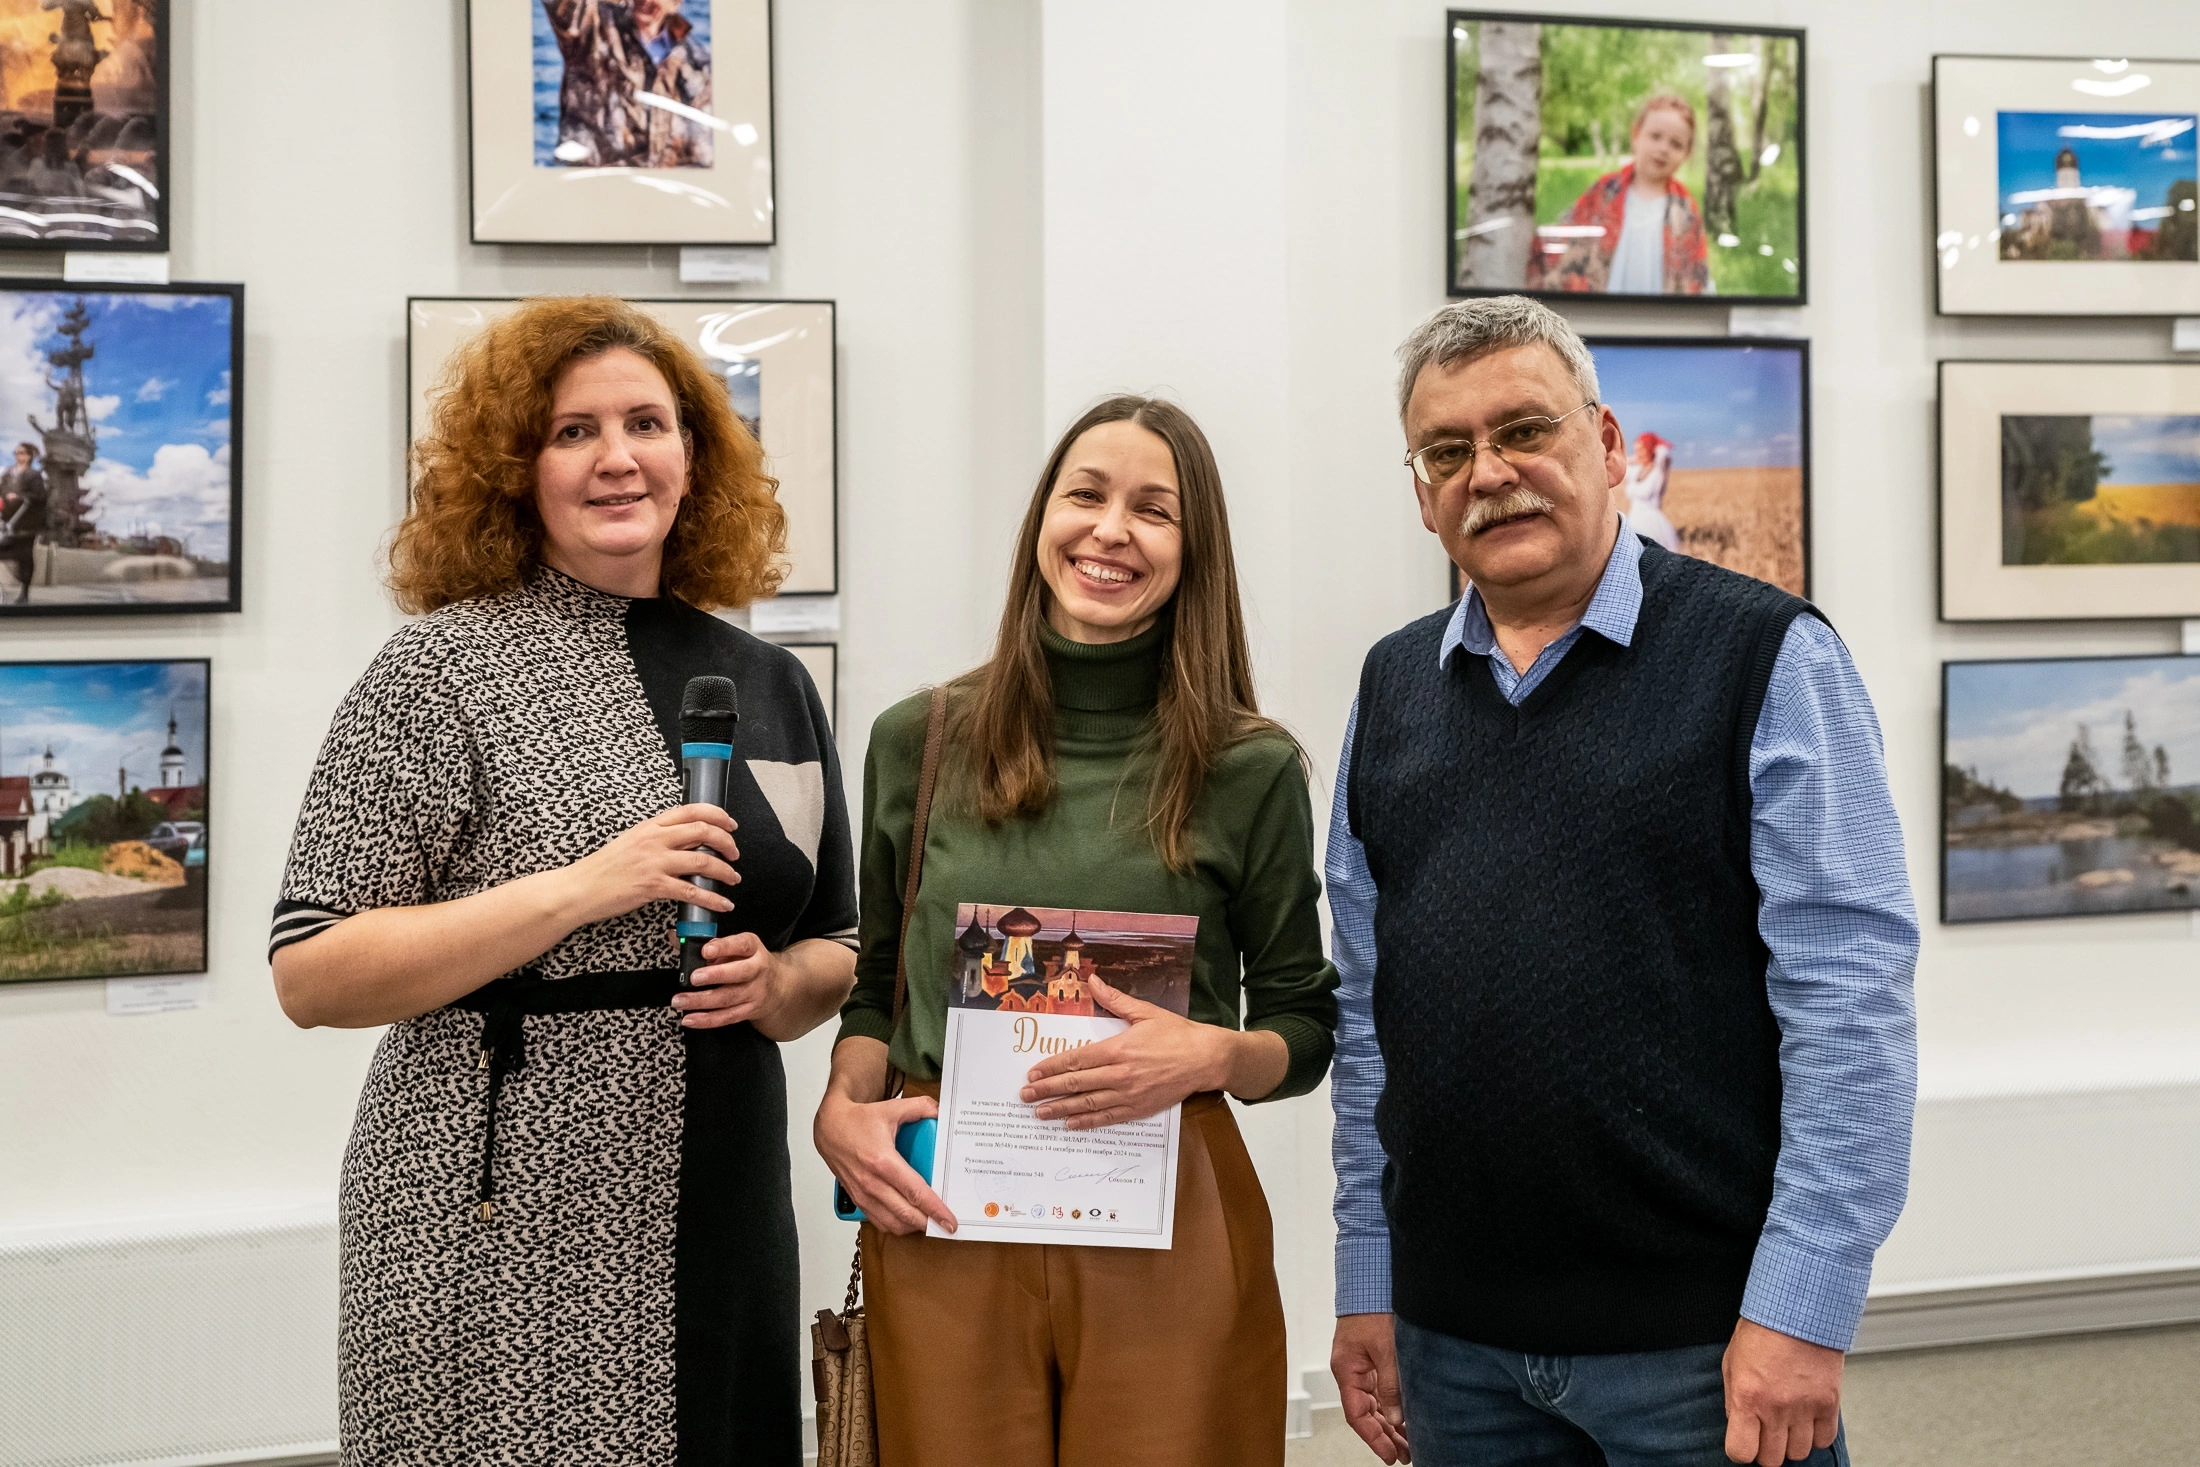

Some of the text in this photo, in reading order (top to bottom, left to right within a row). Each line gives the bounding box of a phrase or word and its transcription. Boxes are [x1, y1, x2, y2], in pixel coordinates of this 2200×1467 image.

[954, 1129, 1002, 1137] фотохудожников
[1119, 1140, 1165, 1148] Художественная
[964, 1157, 1004, 1165] Руководитель
[964, 1167, 1012, 1175] Художественной
[1108, 1176, 1132, 1184] Соколов
